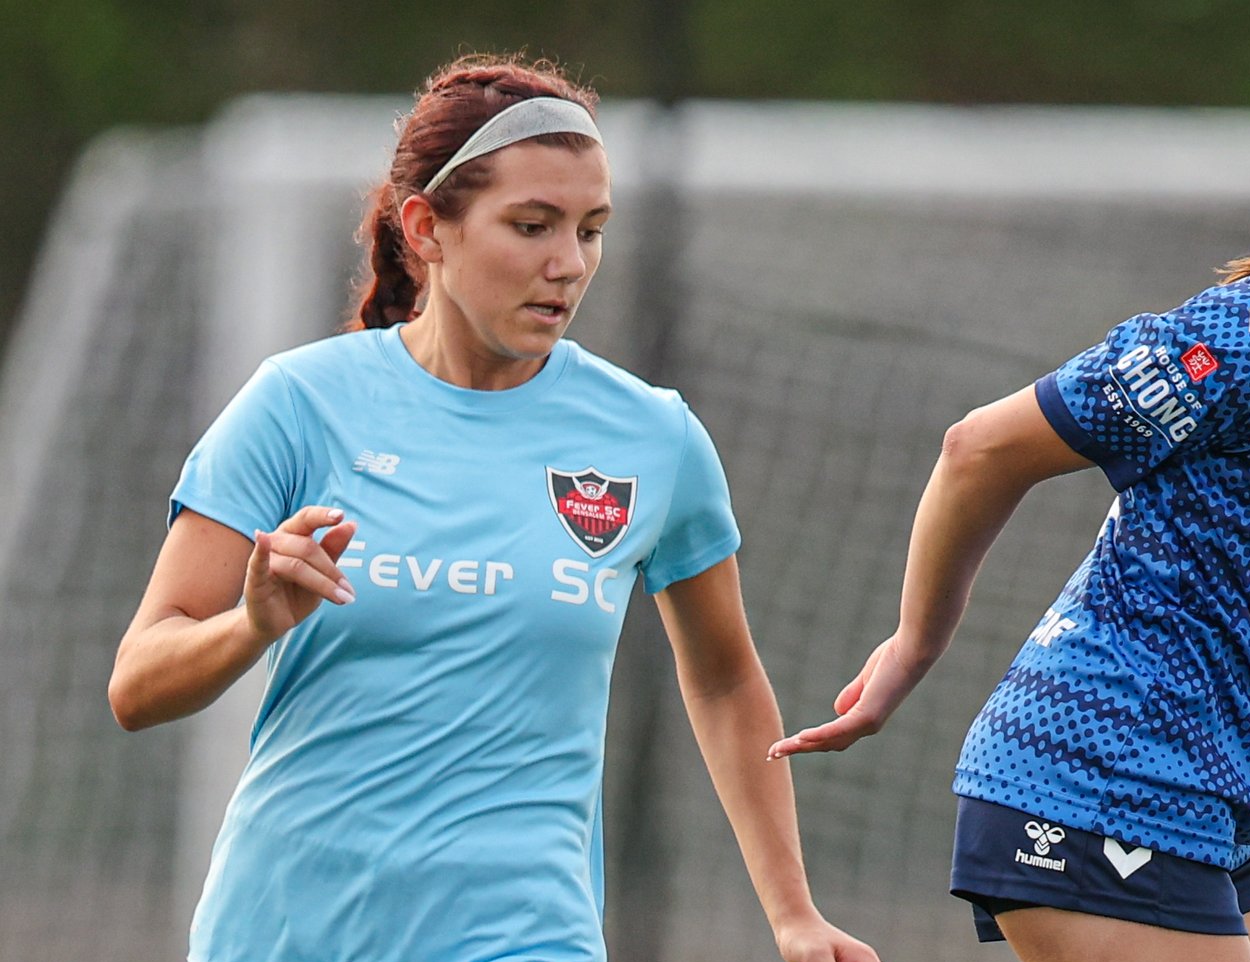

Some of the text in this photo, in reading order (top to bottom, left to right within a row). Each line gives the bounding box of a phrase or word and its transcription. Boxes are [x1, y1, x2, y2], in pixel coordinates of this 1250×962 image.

[1117, 344, 1198, 442] CHONG
[1155, 345, 1202, 411] HOUSE OF
[1102, 383, 1153, 438] EST. 1969
[551, 558, 618, 613] SC
[1015, 848, 1066, 872] hummel
